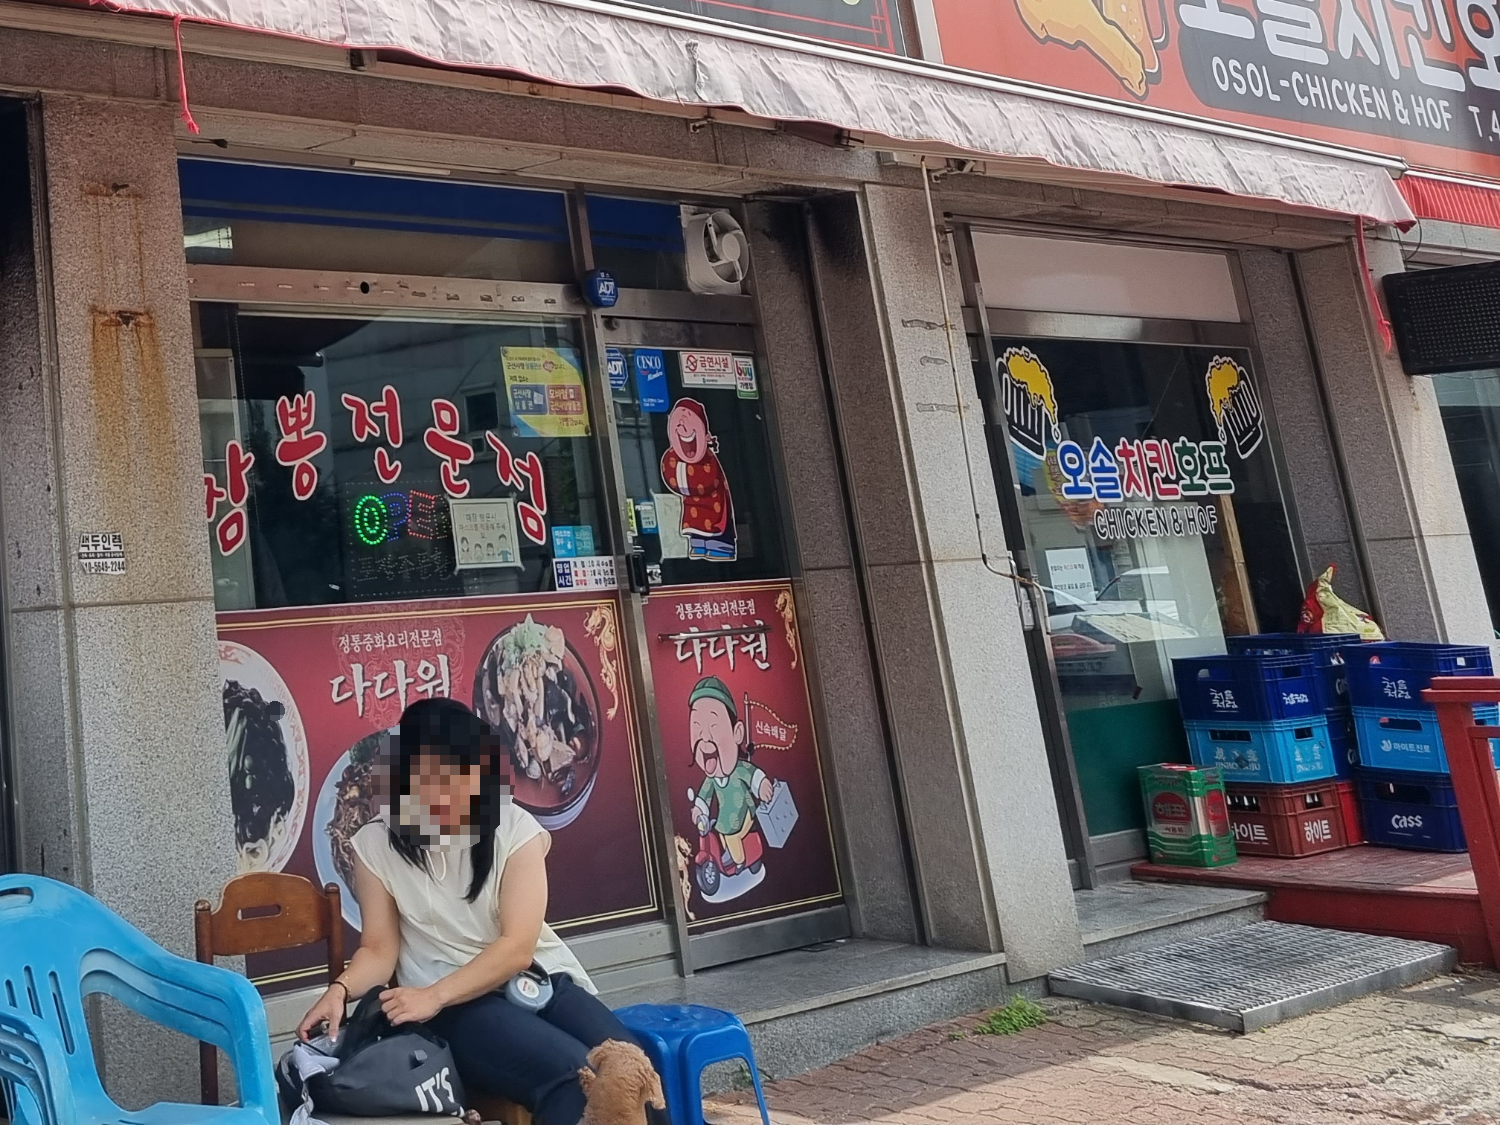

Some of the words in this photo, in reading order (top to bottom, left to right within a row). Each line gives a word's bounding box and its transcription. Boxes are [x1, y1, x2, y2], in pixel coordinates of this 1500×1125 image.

[1211, 55, 1391, 121] OSOL-CHICKEN
[1394, 89, 1411, 124] &
[1414, 91, 1453, 133] HOF
[599, 281, 614, 295] ADT
[608, 360, 623, 377] ADT
[636, 355, 662, 370] CESCO
[699, 355, 730, 369] 금연시설
[1057, 437, 1236, 502] 오솔치킨호프
[1093, 508, 1167, 542] CHICKEN
[1171, 508, 1185, 538] &
[1186, 505, 1219, 535] HOF
[556, 562, 570, 574] 영업
[558, 574, 572, 586] 시간
[675, 599, 756, 620] 정통중화요리전문점
[338, 628, 443, 655] 정통중화요리전문점
[674, 619, 771, 675] 다다원
[754, 719, 788, 744] 신속배달
[1392, 741, 1431, 753] 하이트진로
[1304, 818, 1332, 844] 하이트
[1391, 814, 1424, 830] Cass
[414, 1067, 456, 1114] IT'S
